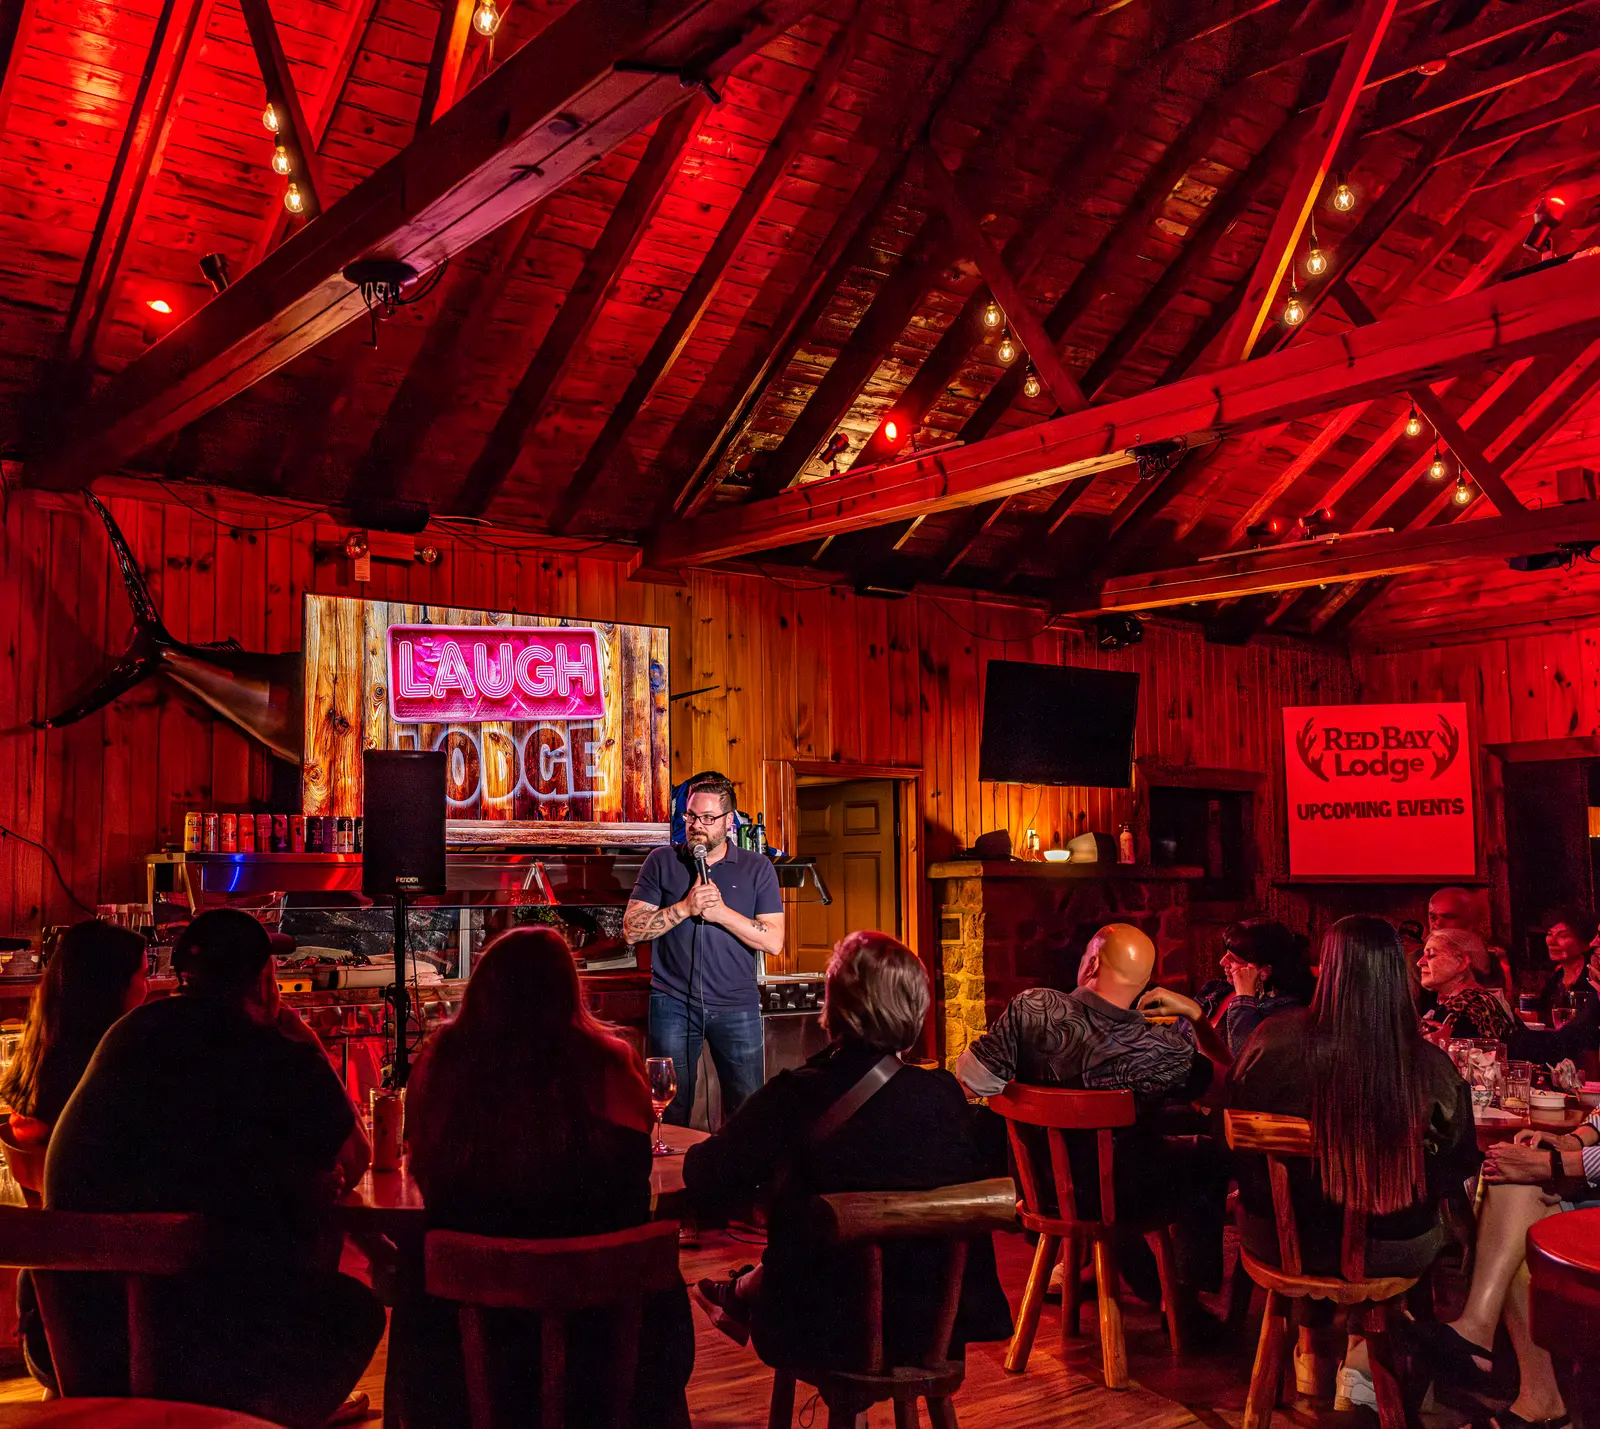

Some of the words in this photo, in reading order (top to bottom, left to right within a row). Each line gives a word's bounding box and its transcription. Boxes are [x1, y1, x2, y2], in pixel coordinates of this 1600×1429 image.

[399, 641, 595, 698] LAUGH
[396, 725, 609, 804] ODGE
[1334, 751, 1425, 783] Lodge
[1296, 800, 1392, 821] UPCOMING
[1397, 797, 1465, 817] EVENTS
